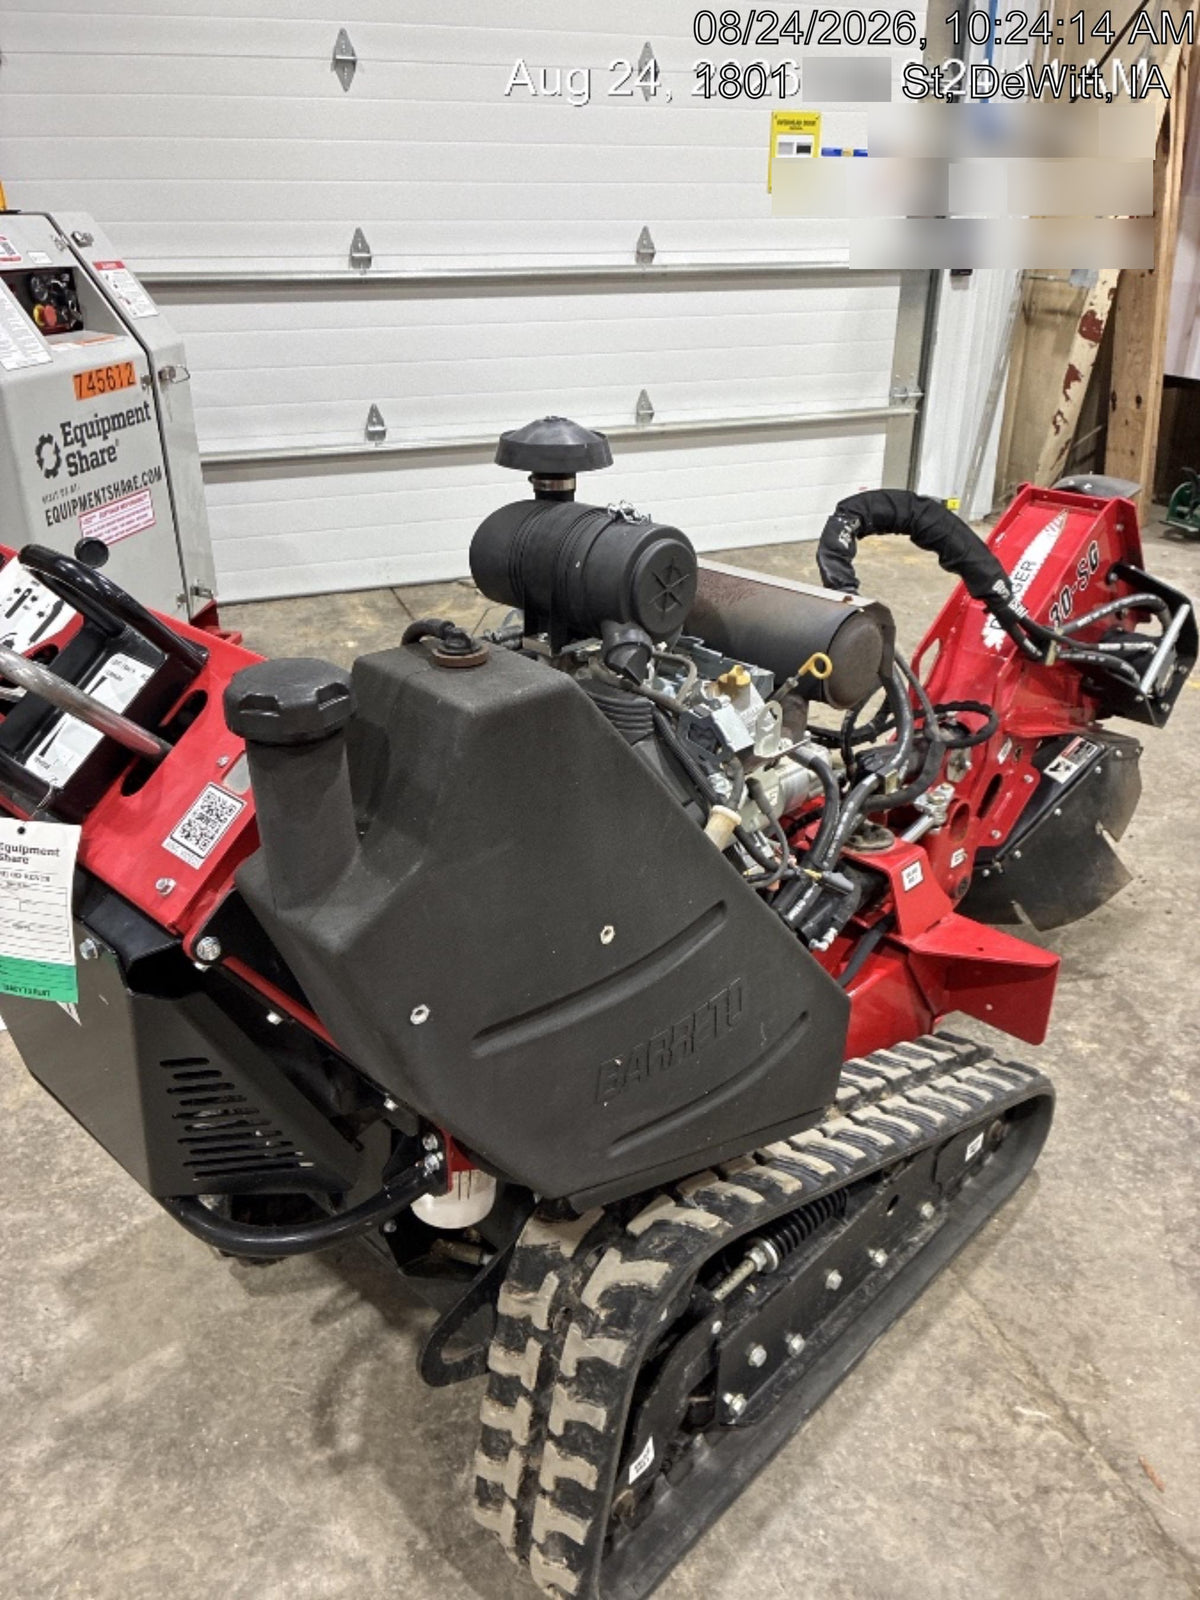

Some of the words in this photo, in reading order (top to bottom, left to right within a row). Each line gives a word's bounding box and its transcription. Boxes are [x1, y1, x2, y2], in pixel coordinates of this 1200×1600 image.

[73, 361, 136, 400] 745612
[60, 400, 151, 448] Equipment
[65, 444, 118, 477] Share
[45, 465, 163, 527] EQUIPMENTSHARE.COM
[595, 977, 743, 1106] BARRETO
